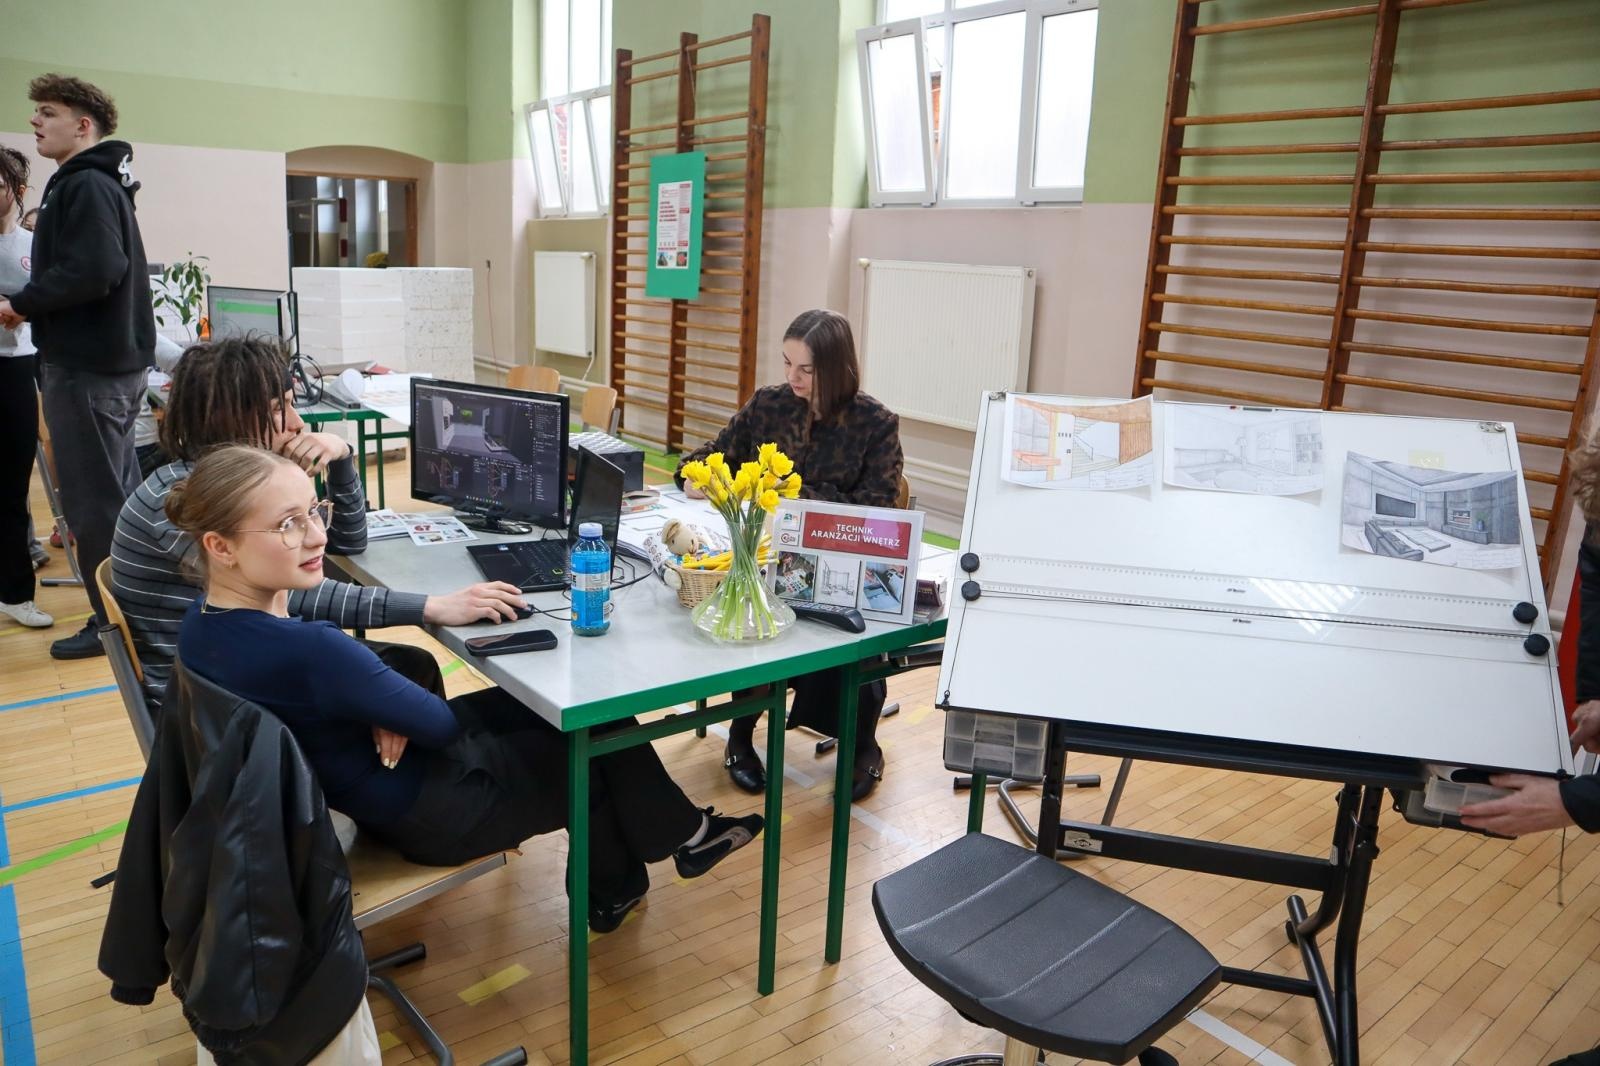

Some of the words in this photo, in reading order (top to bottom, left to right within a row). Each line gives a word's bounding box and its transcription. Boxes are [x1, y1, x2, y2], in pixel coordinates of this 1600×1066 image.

[836, 524, 873, 535] TECHNIK
[811, 530, 860, 542] ARANŻACJI
[863, 537, 900, 547] WNĘTRZ
